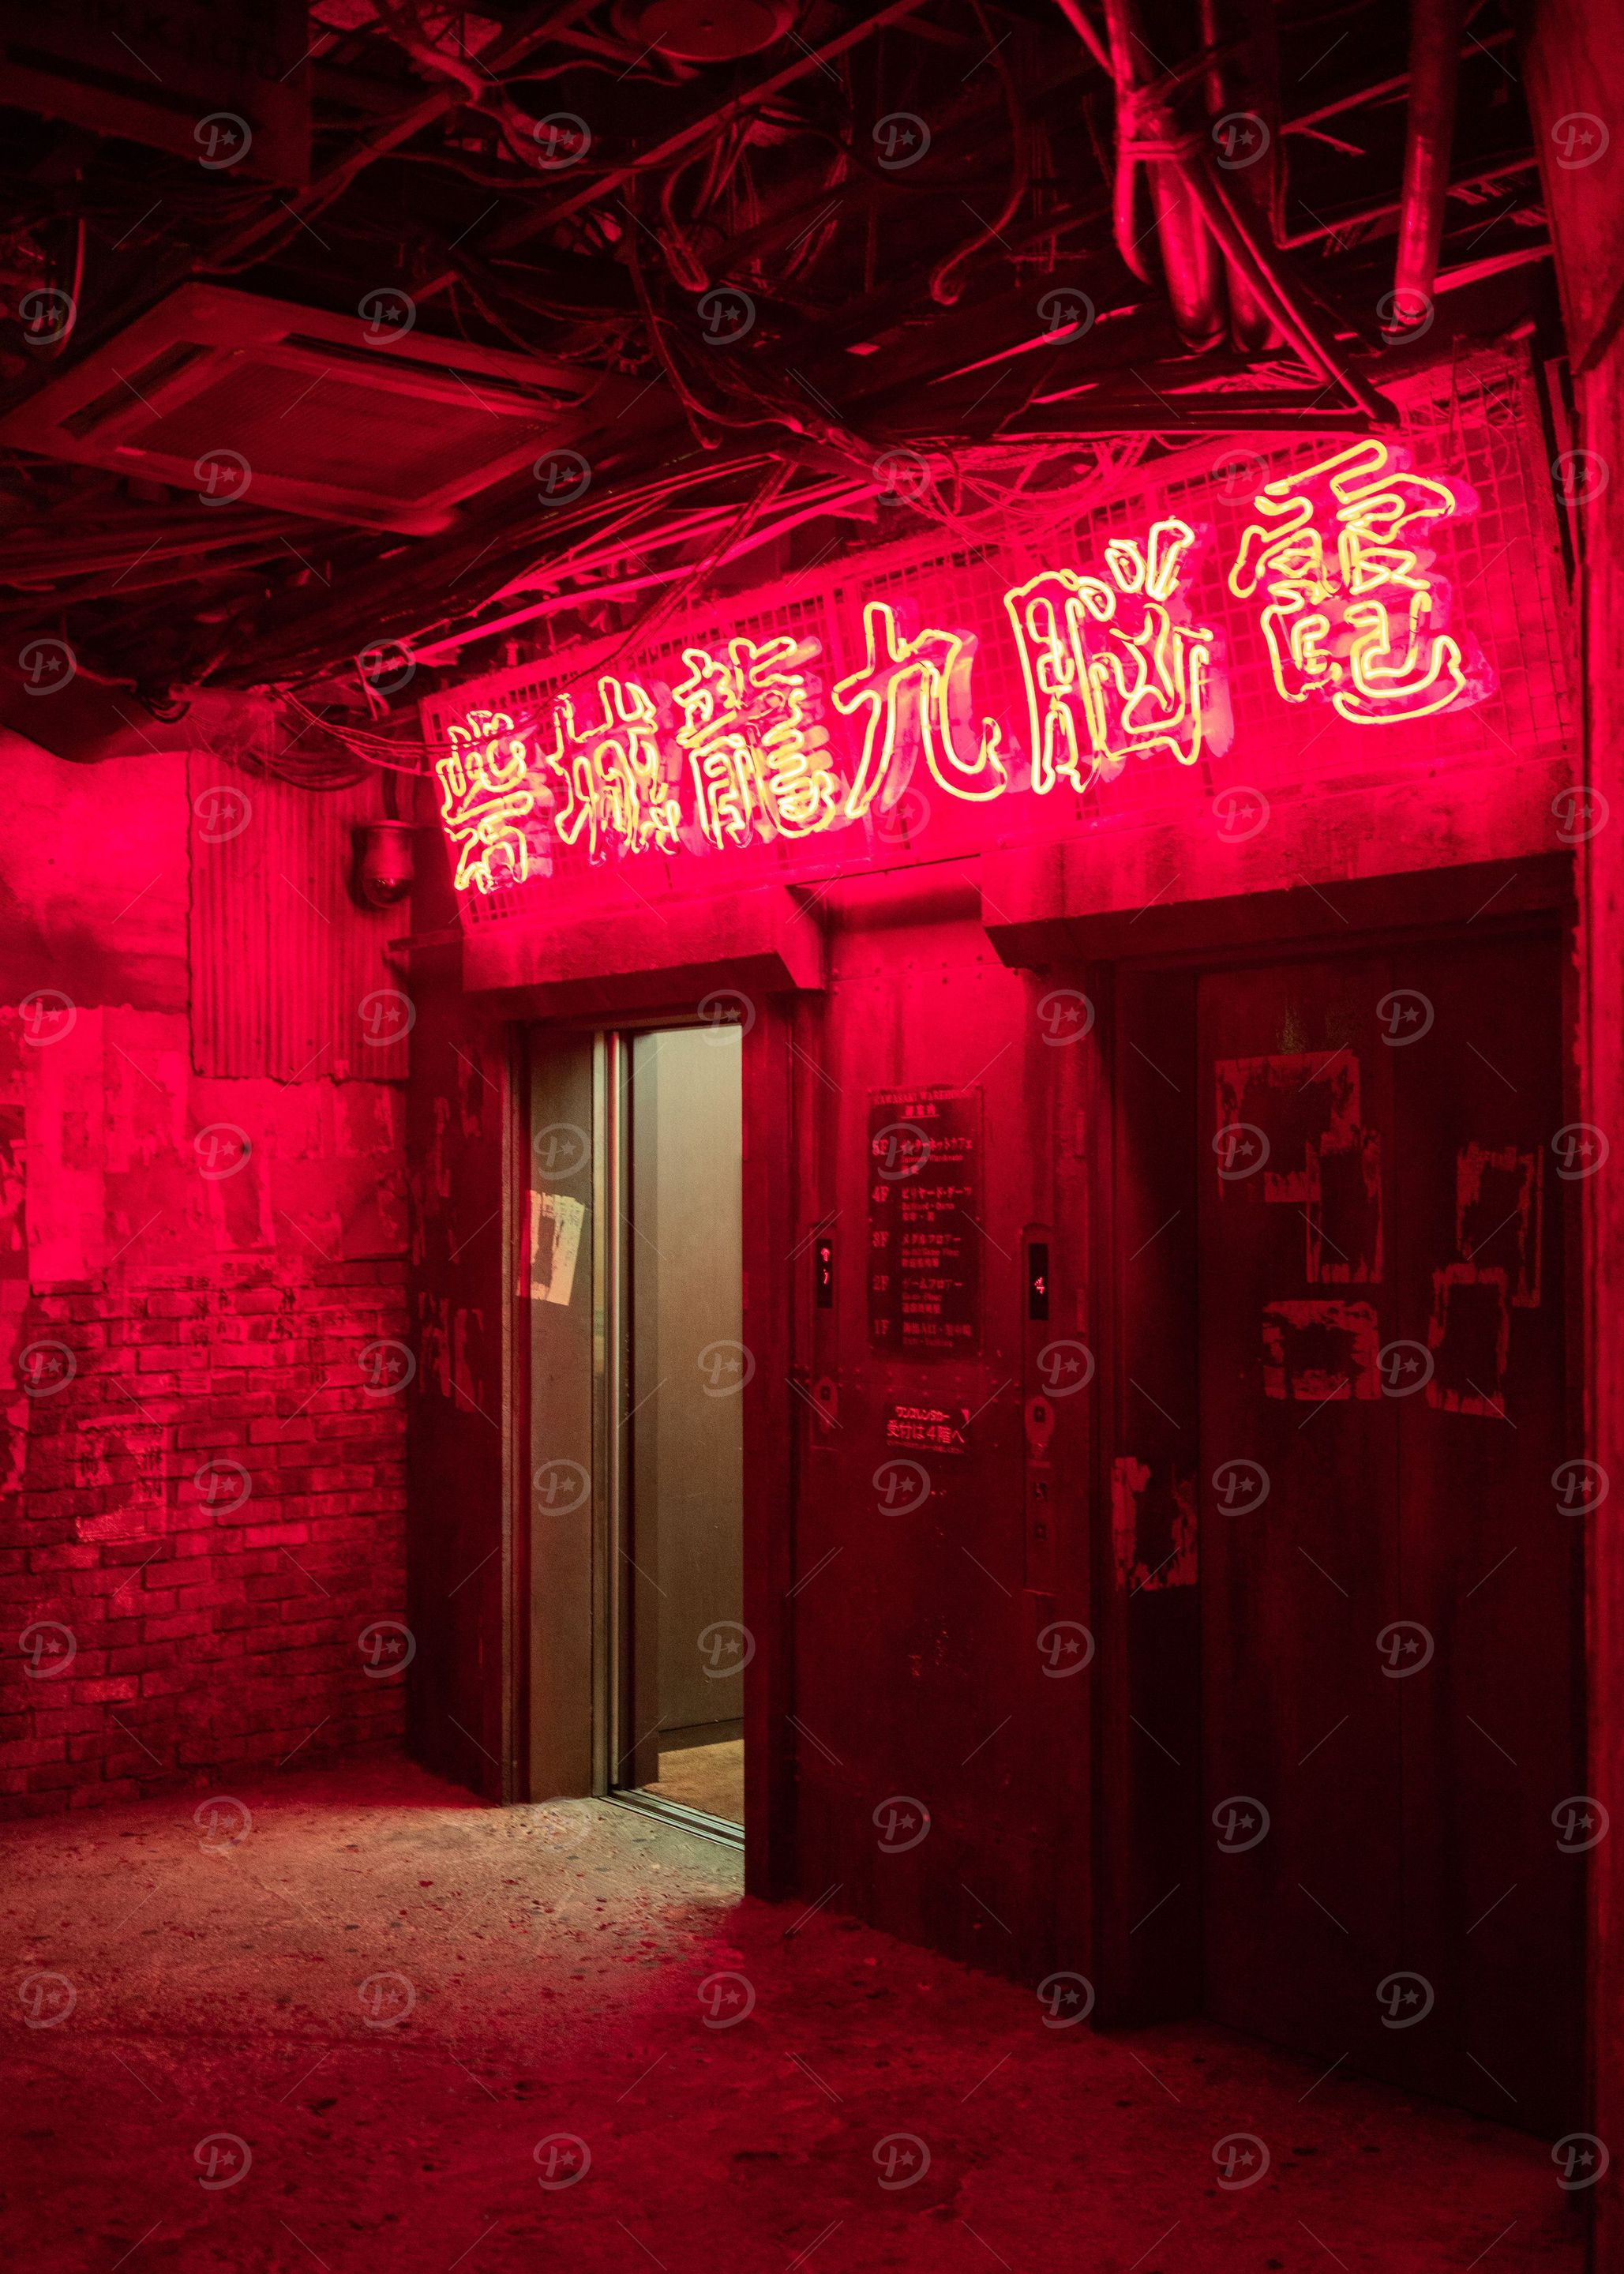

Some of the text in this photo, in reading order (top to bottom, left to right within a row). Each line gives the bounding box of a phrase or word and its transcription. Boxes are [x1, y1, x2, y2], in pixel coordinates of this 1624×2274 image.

[872, 1186, 890, 1203] 4F
[872, 1231, 890, 1248] 3F
[872, 1275, 890, 1291] 2F
[1033, 1276, 1046, 1295] 4
[873, 1319, 890, 1335] 1F
